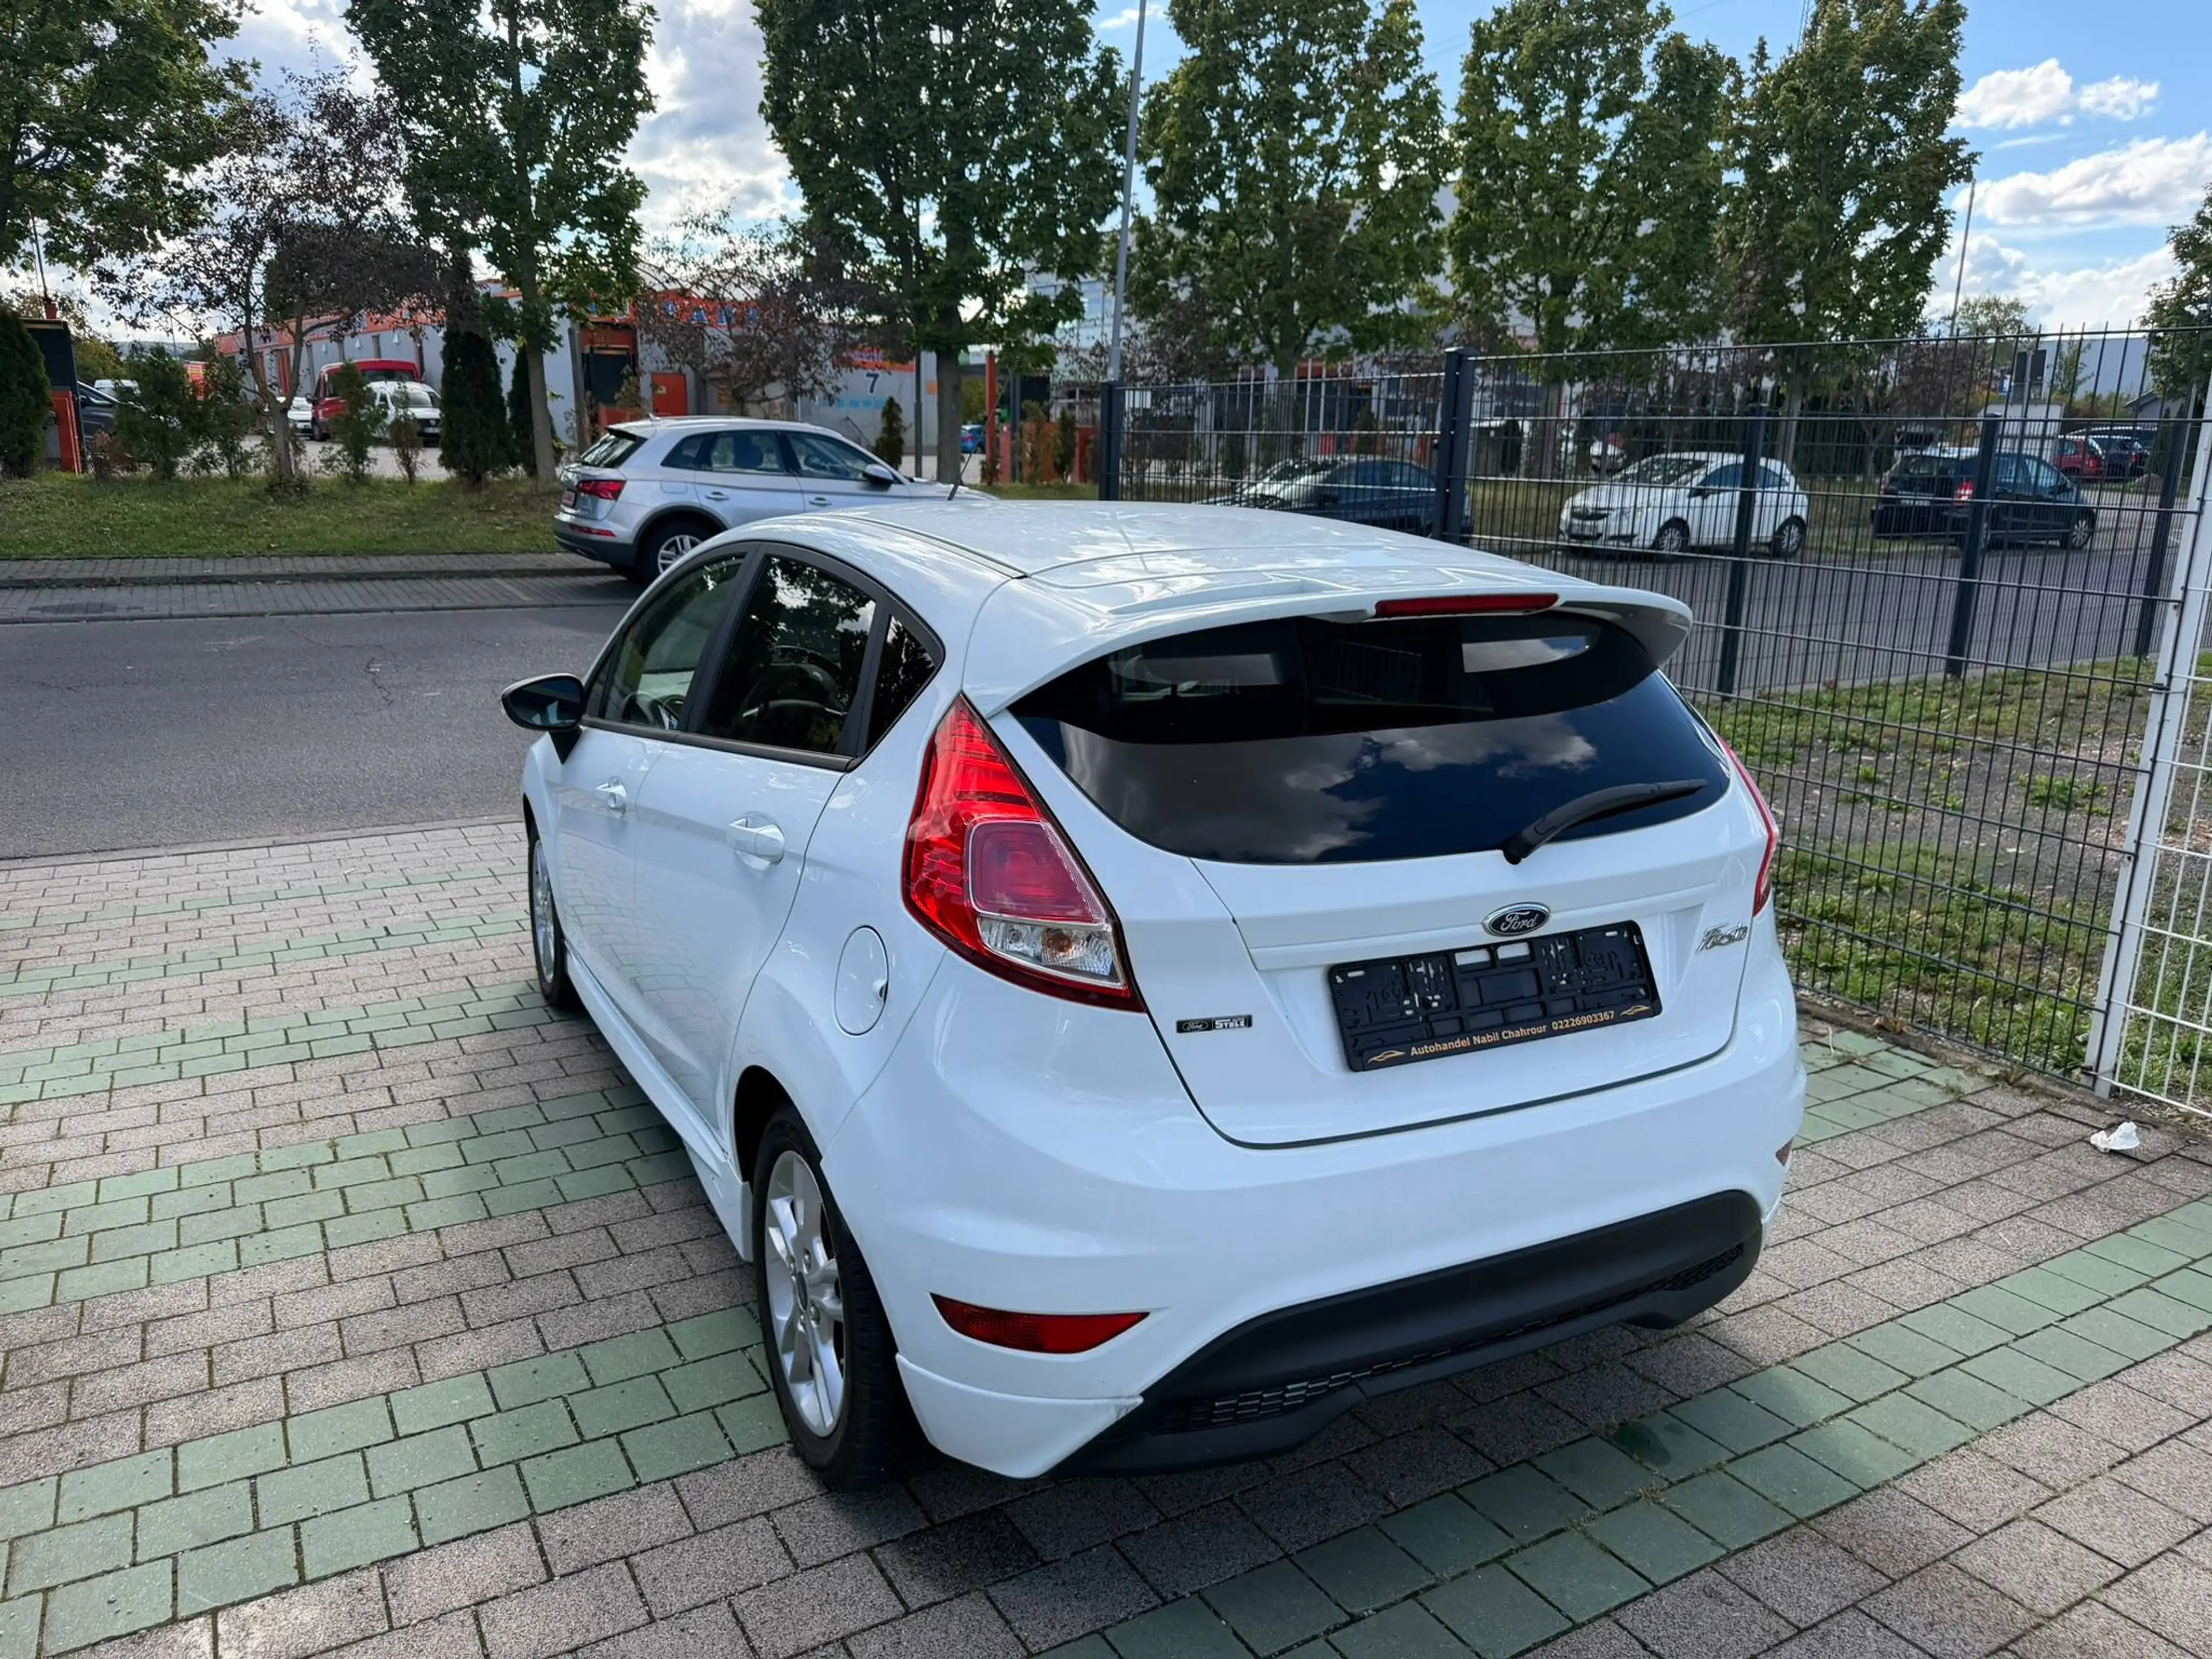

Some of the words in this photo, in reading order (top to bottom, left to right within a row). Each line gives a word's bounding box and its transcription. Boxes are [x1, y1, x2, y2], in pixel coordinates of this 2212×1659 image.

[866, 373, 880, 394] 7
[1500, 911, 1539, 931] Ford
[1411, 1036, 1471, 1057] Autohandel
[1472, 1031, 1501, 1046] Nabil
[1501, 1024, 1548, 1040] Chahrour
[1551, 1010, 1615, 1031] 02226903367
